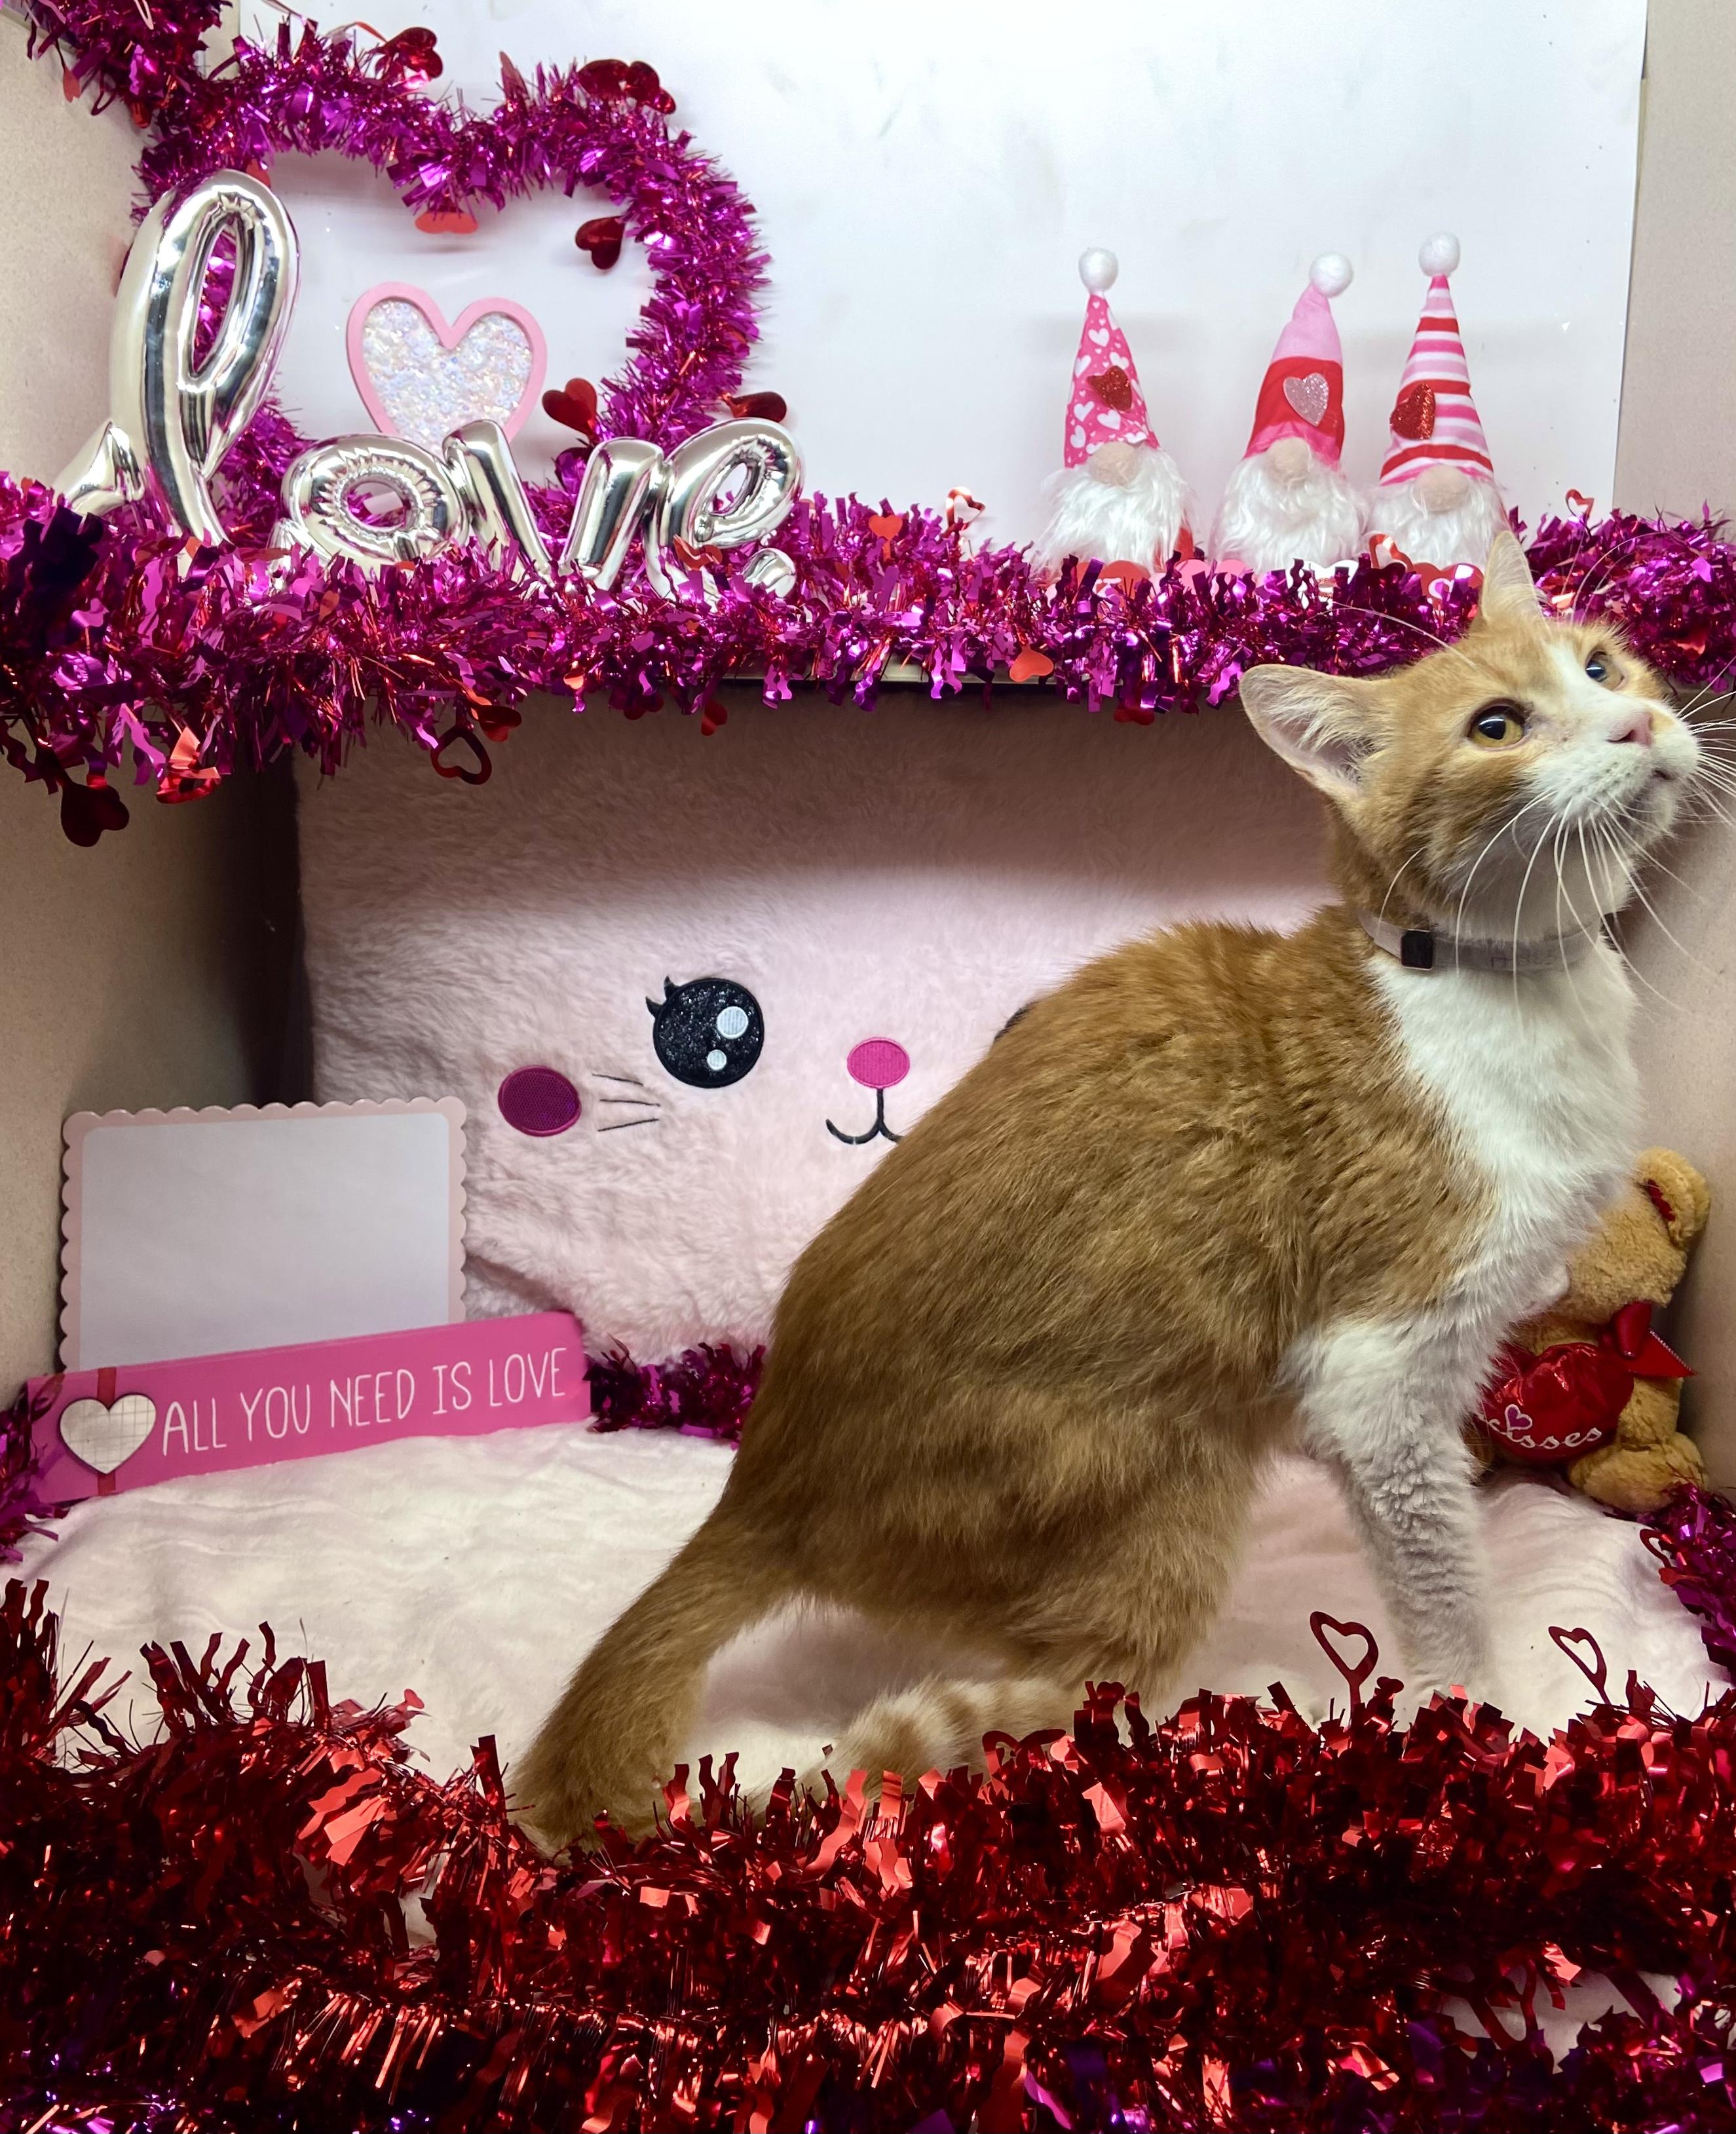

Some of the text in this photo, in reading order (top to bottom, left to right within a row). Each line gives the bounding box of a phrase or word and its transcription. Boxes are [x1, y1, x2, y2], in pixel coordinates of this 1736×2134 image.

[55, 168, 804, 599] love
[162, 1347, 567, 1456] ALL YOU NEED IS LOVE
